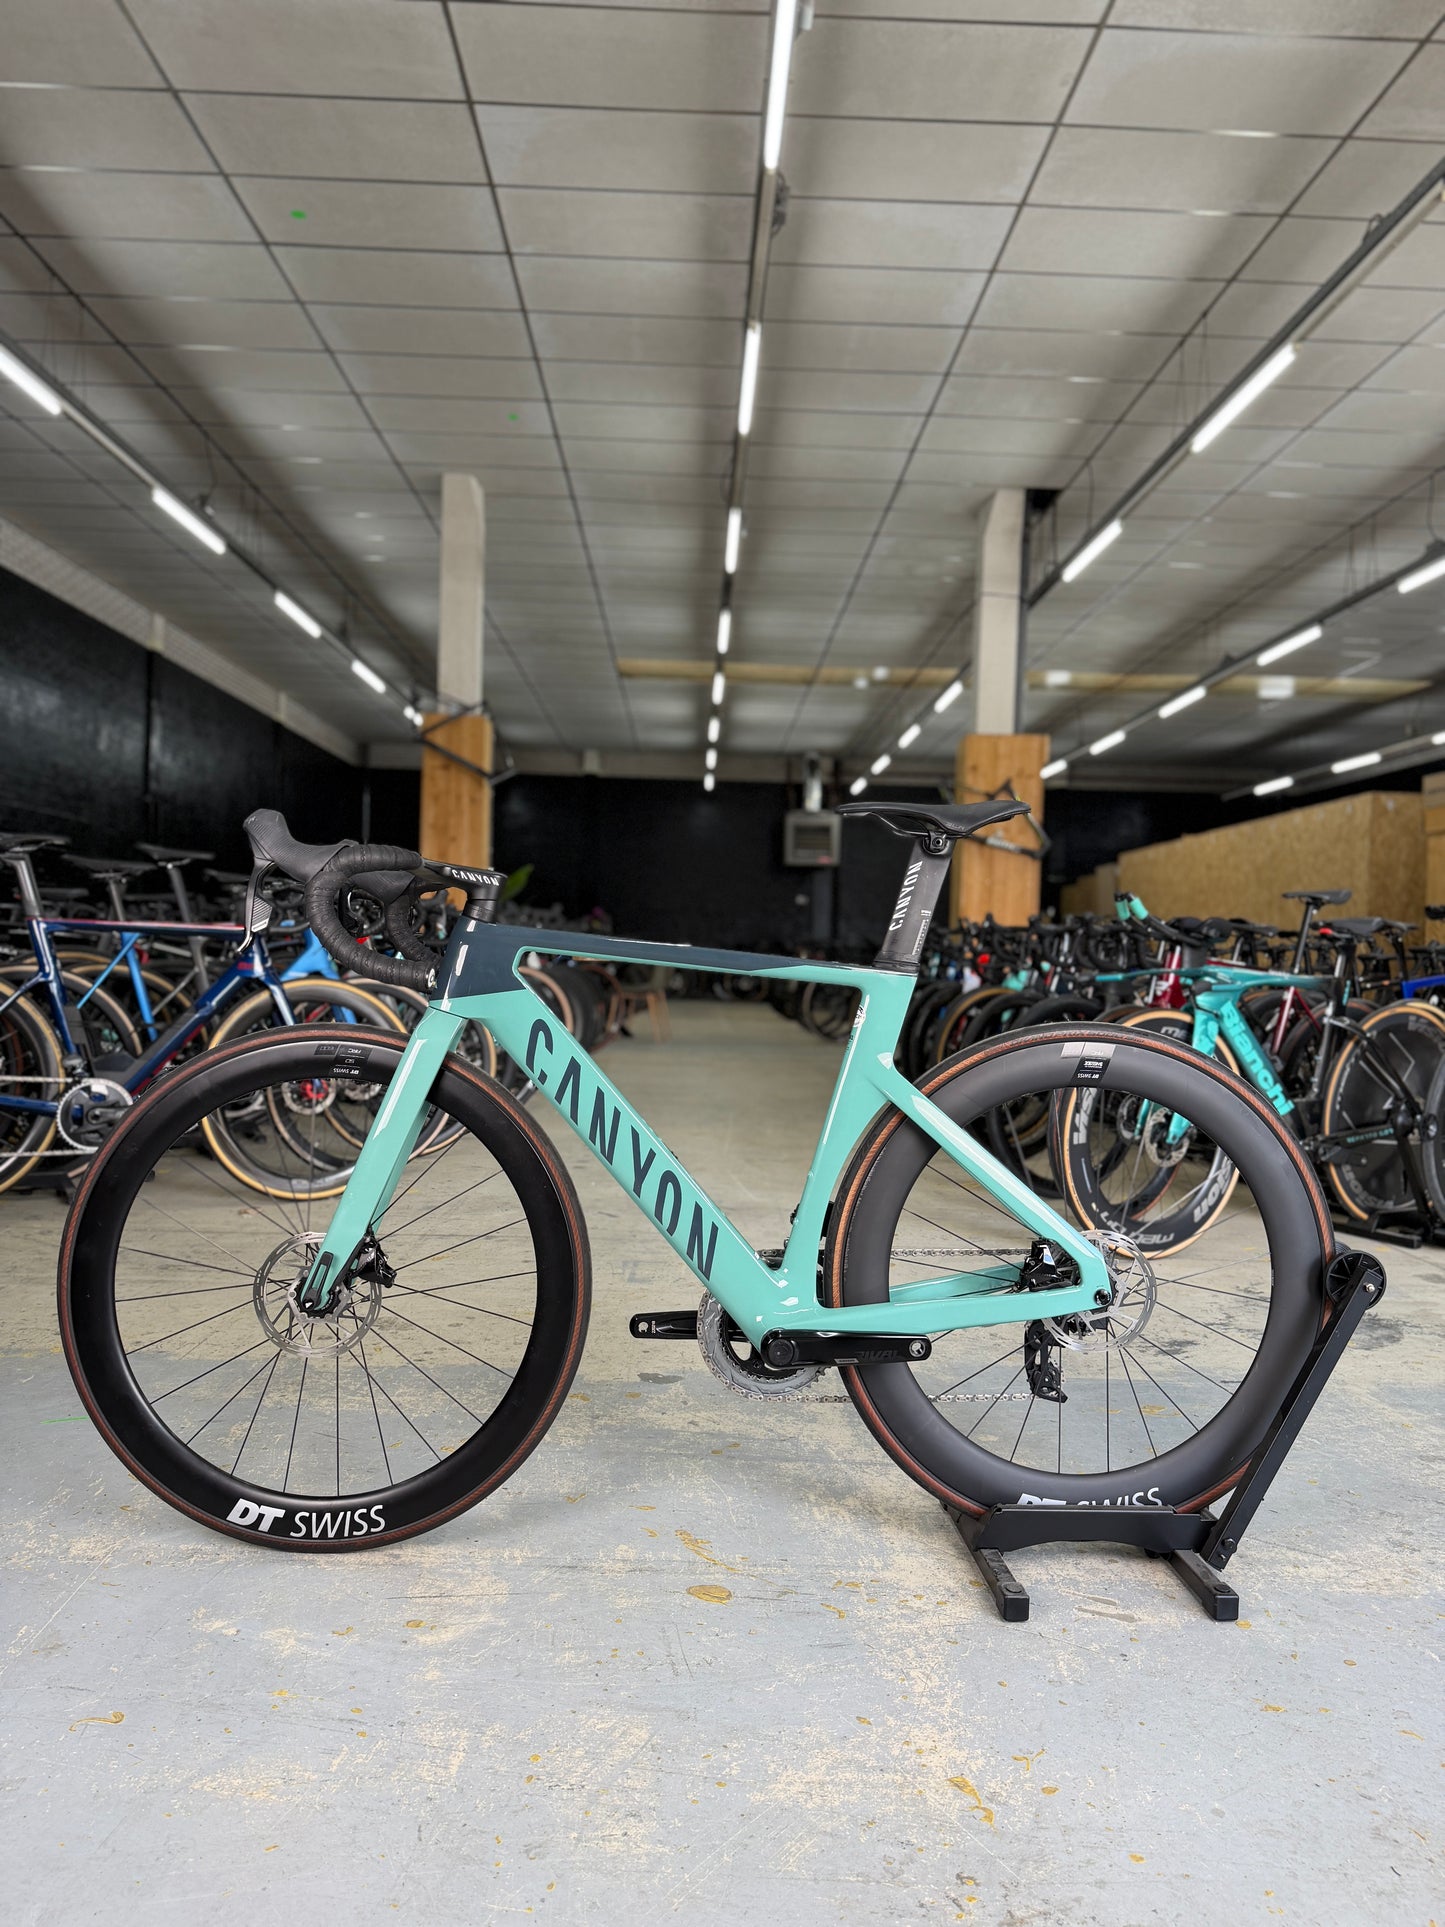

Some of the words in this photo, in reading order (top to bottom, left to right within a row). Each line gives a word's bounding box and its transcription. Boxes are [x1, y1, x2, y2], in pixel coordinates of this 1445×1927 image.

[451, 869, 500, 886] CANYON
[889, 861, 923, 931] CANYON
[1220, 1000, 1296, 1117] Bianchi
[525, 1018, 719, 1281] CANYON
[226, 1498, 286, 1533] DT
[290, 1504, 386, 1539] SWISS
